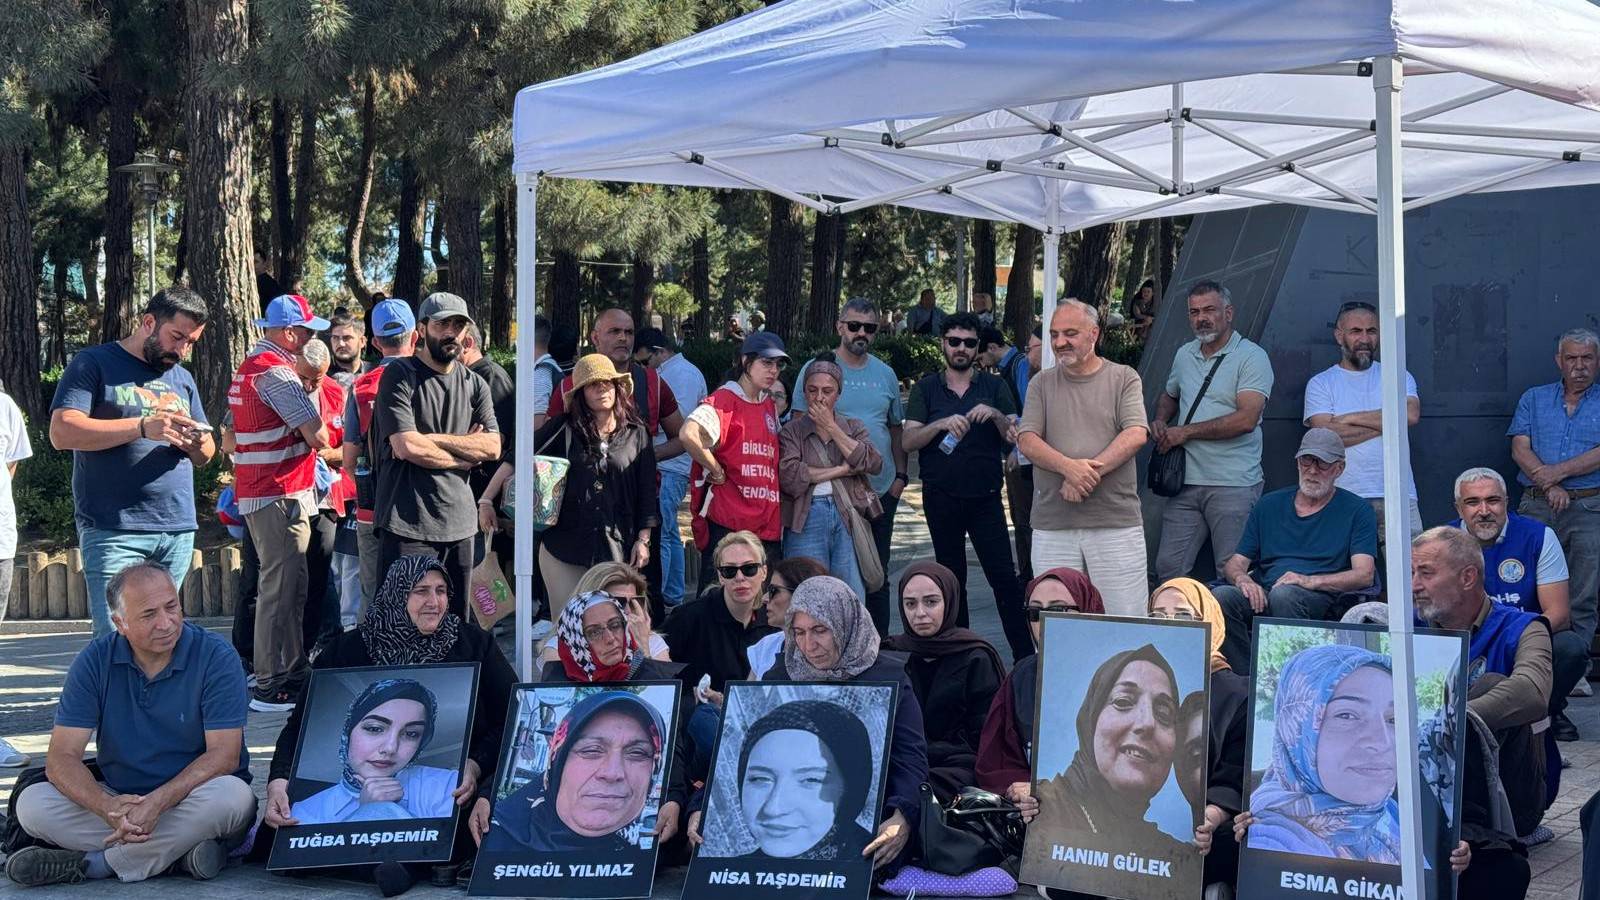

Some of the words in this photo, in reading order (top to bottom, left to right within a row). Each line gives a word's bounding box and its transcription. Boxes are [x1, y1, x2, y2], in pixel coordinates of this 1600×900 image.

[289, 832, 346, 849] TUĞBA
[350, 827, 439, 847] TAŞDEMİR
[493, 862, 564, 880] ŞENGÜL
[568, 864, 635, 878] YILMAZ
[1052, 844, 1109, 868] HANIM
[1113, 852, 1172, 878] GÜLEK
[708, 868, 751, 885] NİSA
[755, 871, 847, 890] TAŞDEMİR
[1280, 871, 1339, 895] ESMA
